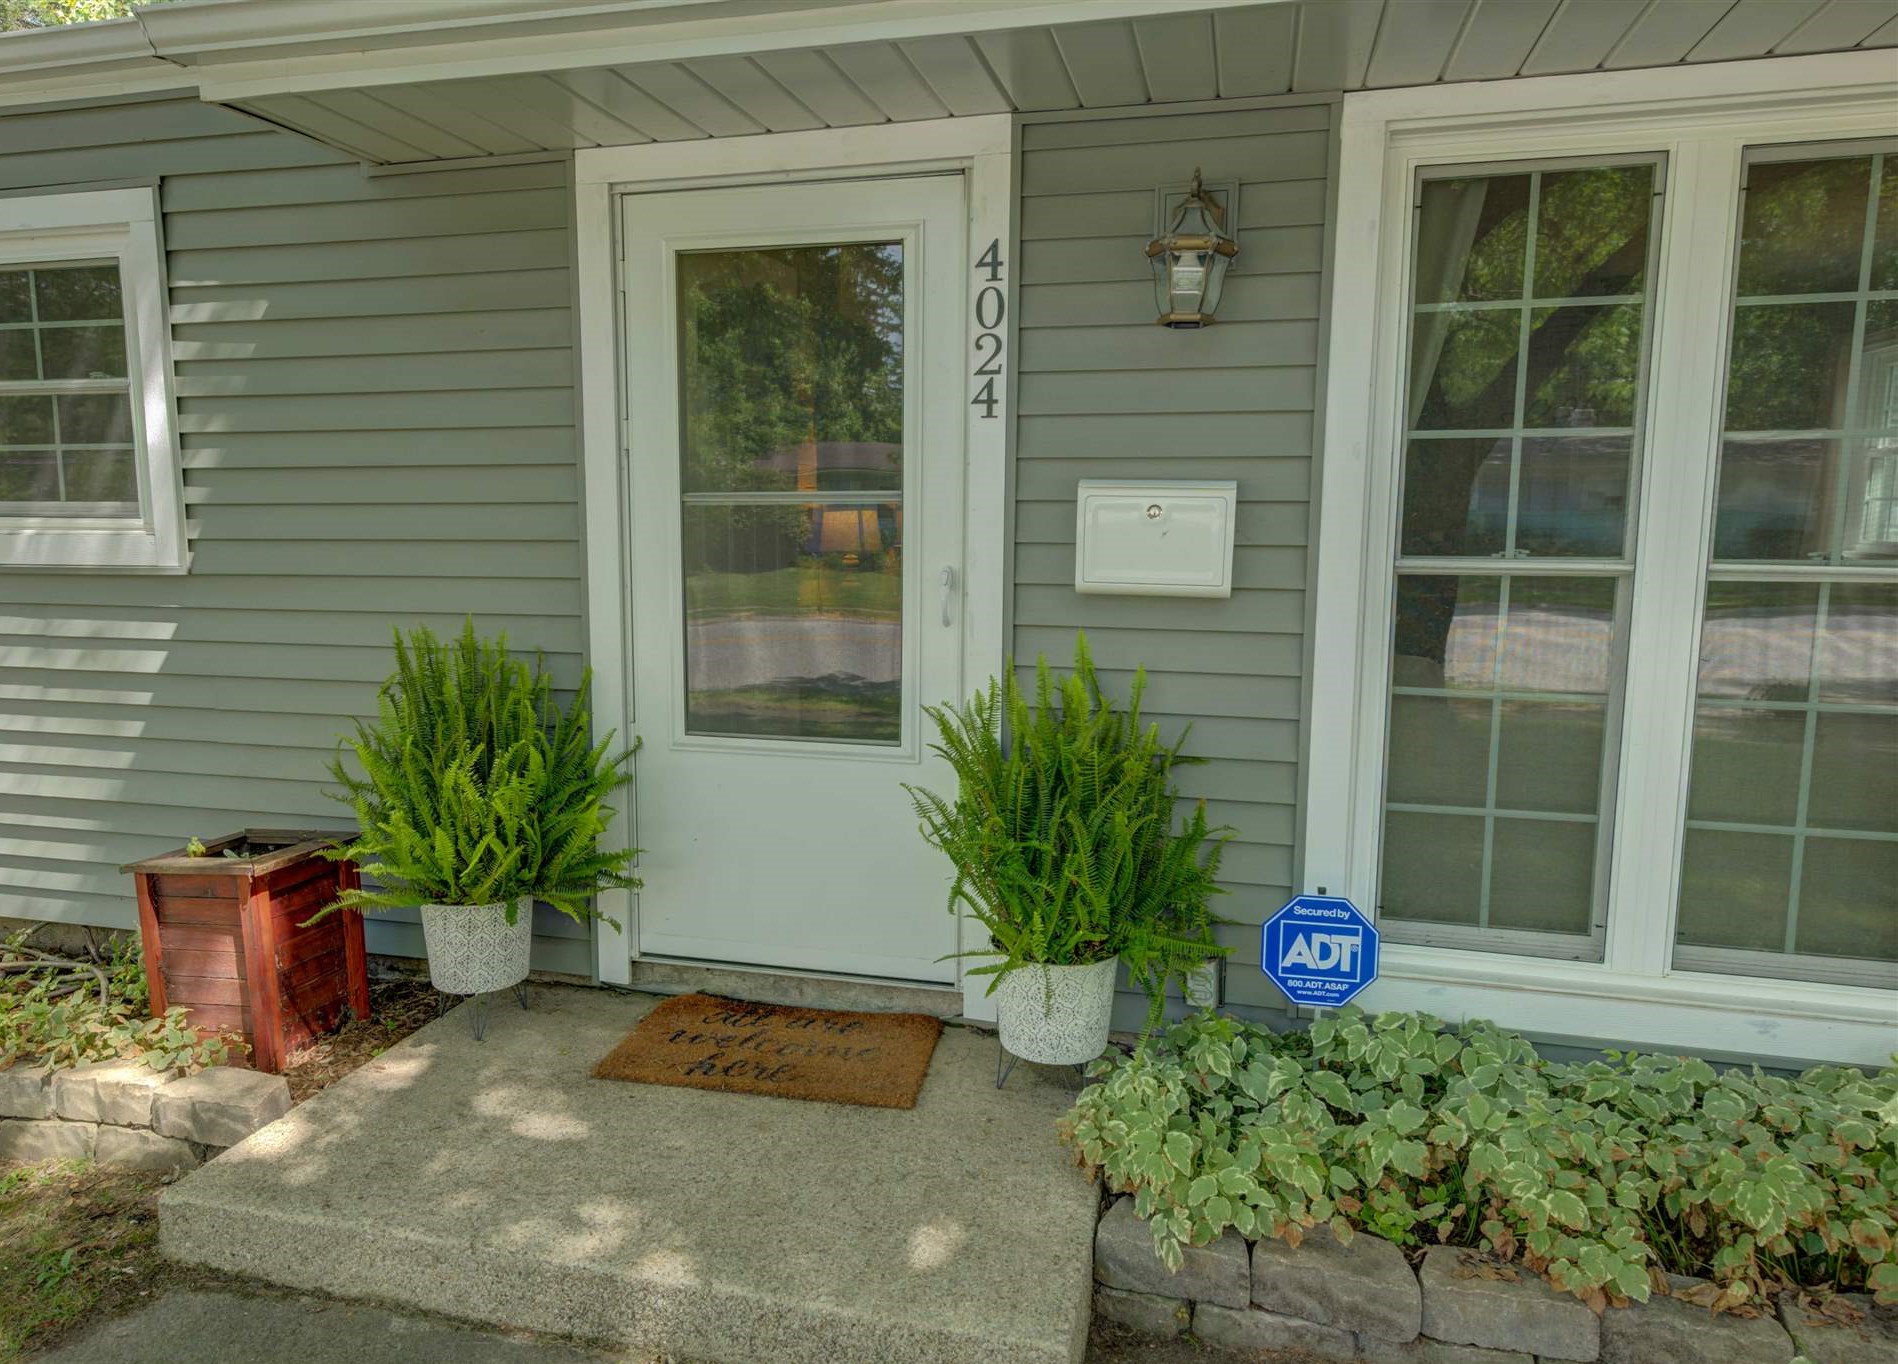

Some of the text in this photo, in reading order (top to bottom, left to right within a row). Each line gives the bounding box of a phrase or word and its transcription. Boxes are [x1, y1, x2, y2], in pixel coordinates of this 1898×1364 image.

[970, 237, 1005, 419] 4024
[1293, 905, 1351, 920] Secured by
[1281, 932, 1361, 972] ADT
[1287, 979, 1349, 991] 800.ADT.ASAP
[683, 1051, 797, 1082] here
